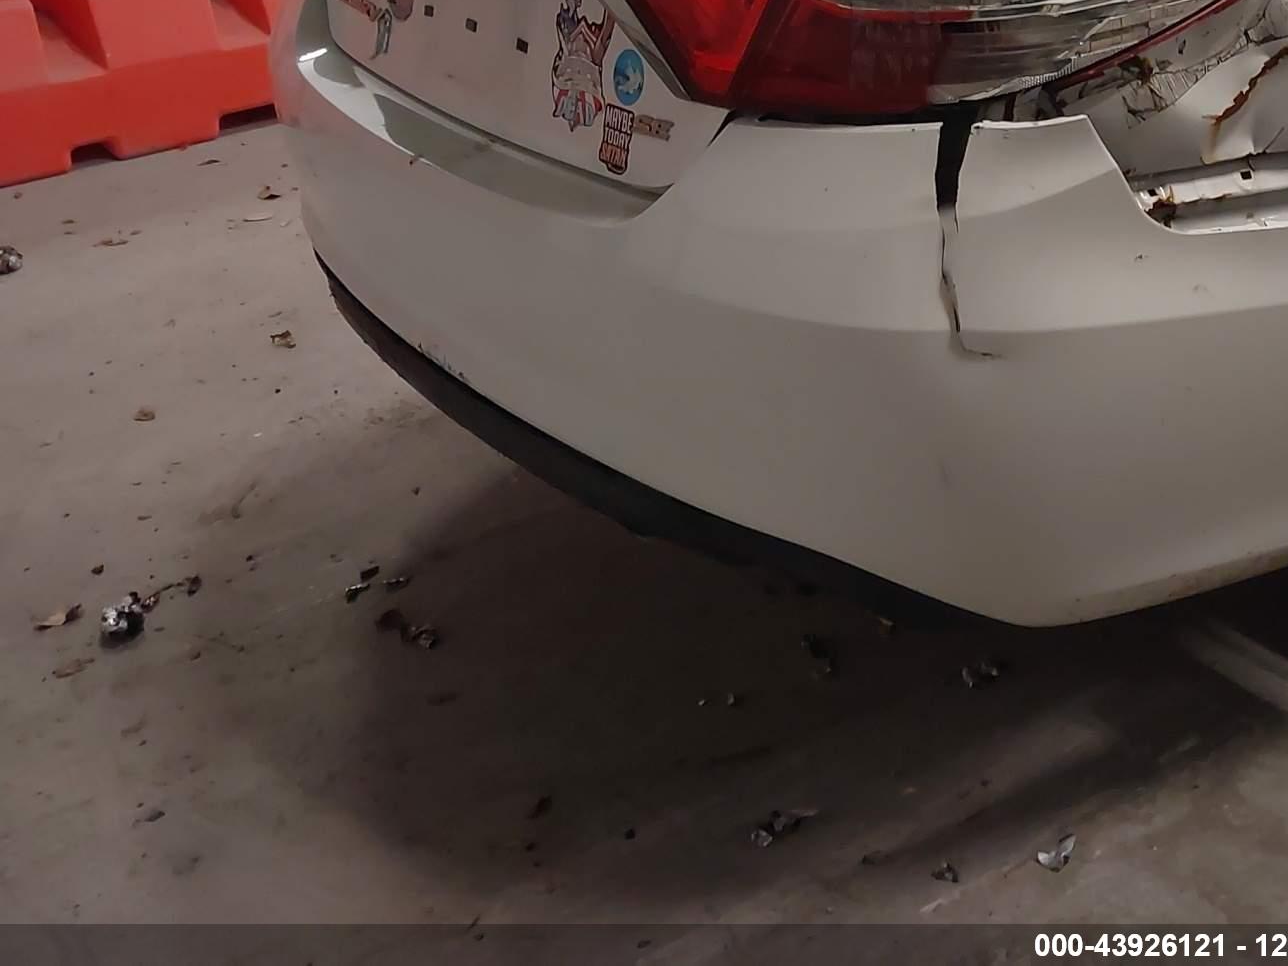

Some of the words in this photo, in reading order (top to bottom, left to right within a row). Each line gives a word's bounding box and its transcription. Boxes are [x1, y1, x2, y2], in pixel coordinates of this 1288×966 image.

[606, 105, 633, 134] MAYBE
[603, 126, 630, 150] TODAY
[600, 141, 628, 166] SATAN
